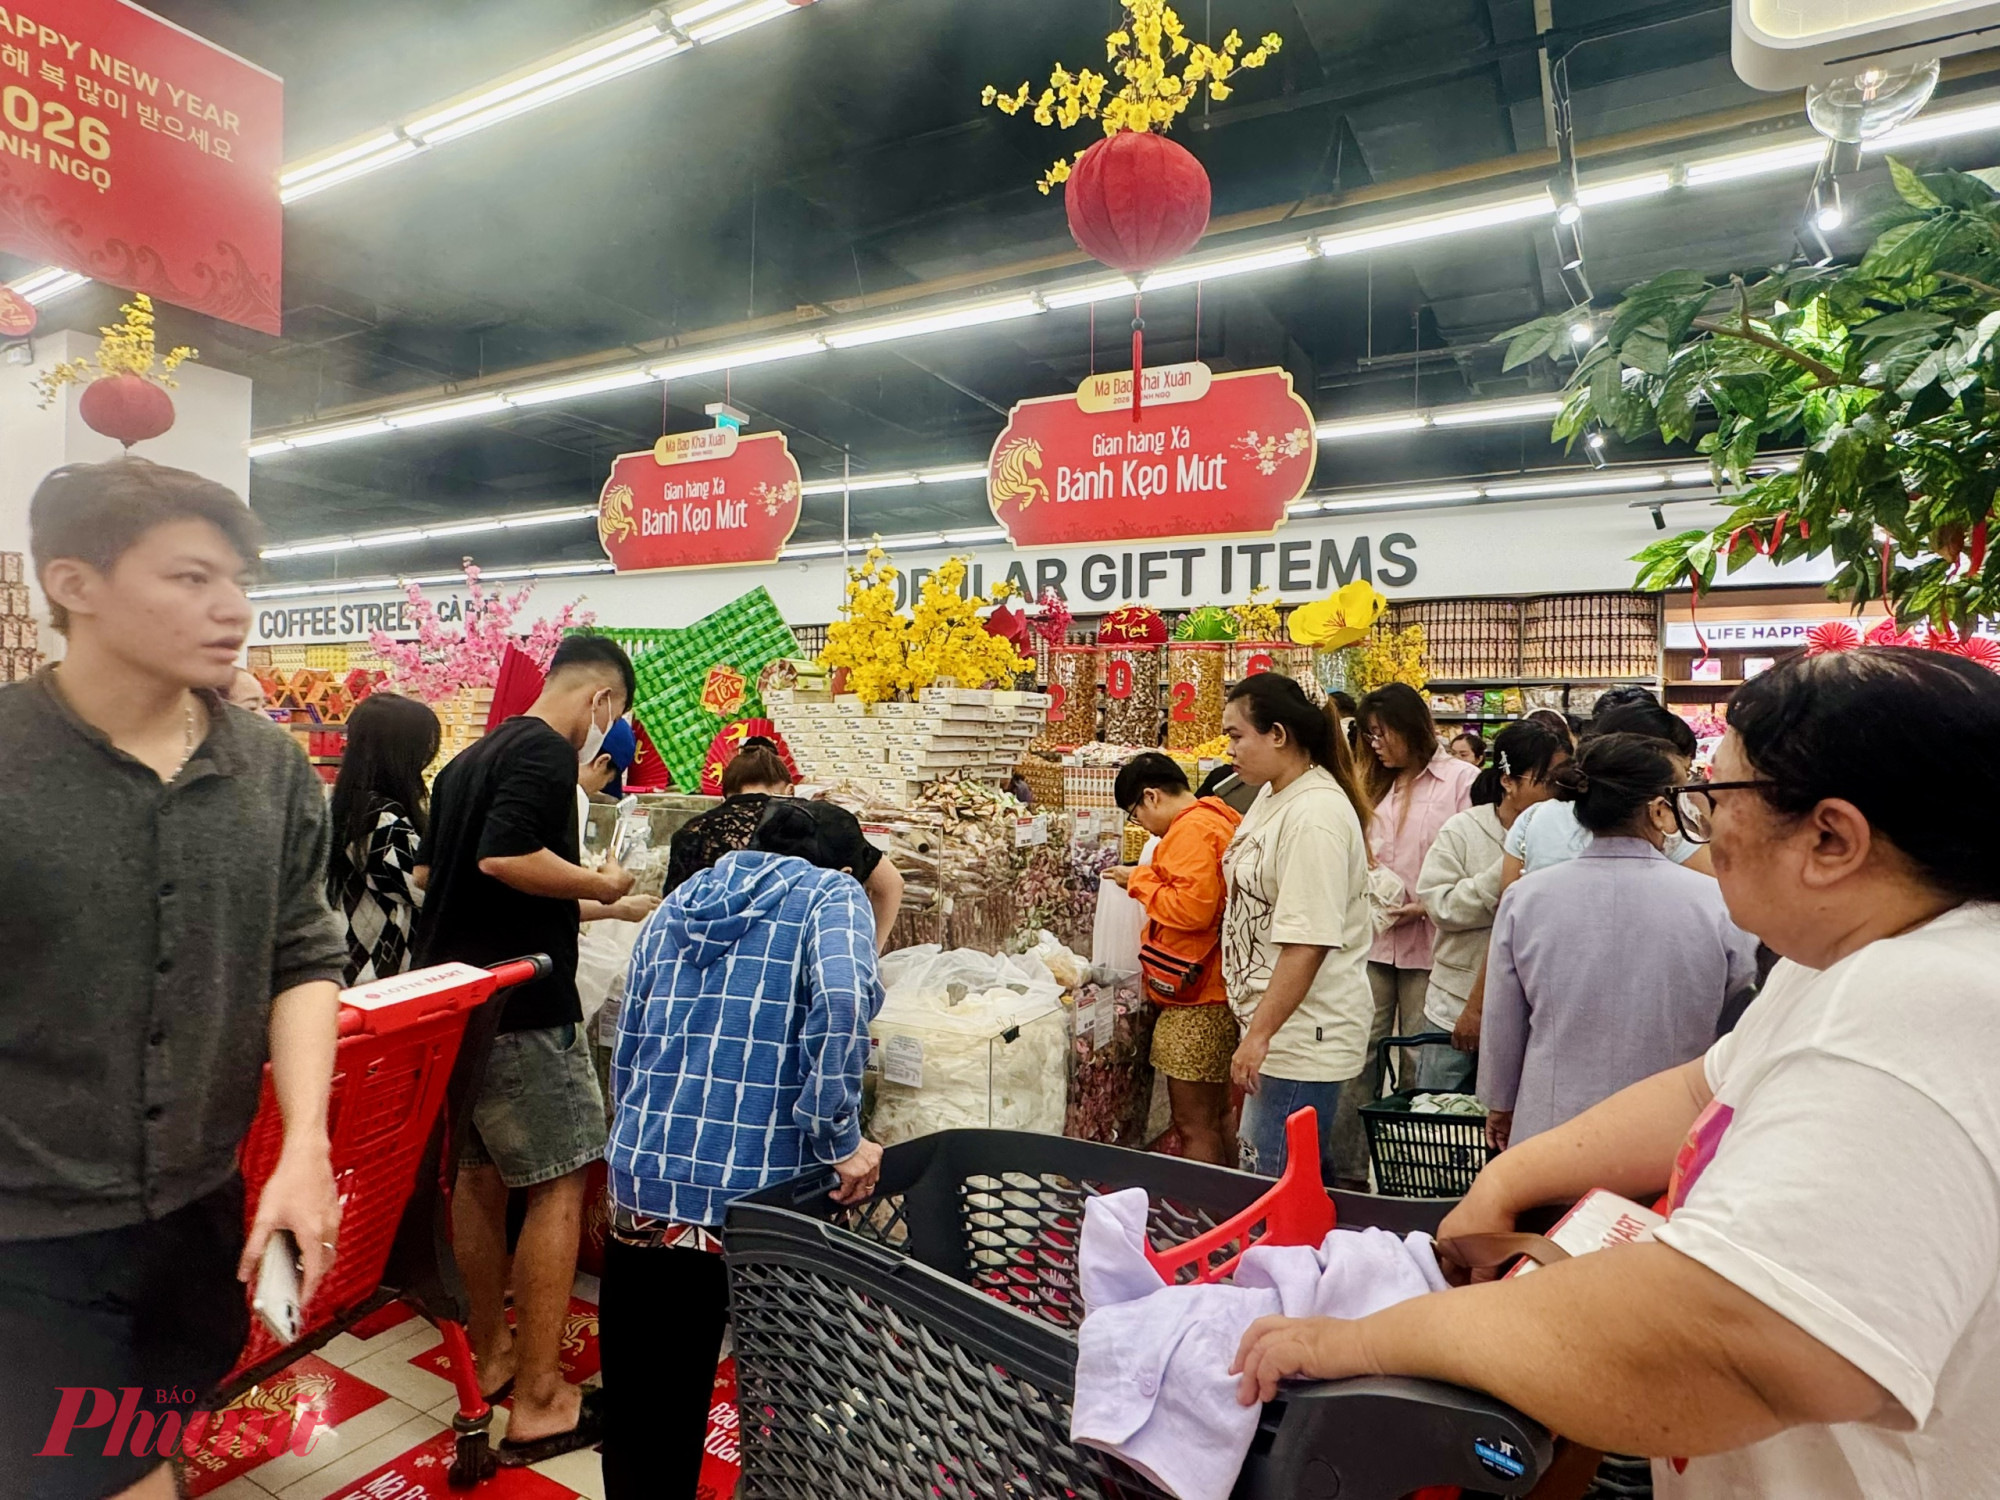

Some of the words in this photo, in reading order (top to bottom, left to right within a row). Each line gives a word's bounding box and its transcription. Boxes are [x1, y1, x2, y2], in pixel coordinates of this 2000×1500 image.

[0, 5, 82, 60] APPY
[90, 47, 160, 97] NEW
[165, 82, 240, 136] YEAR
[3, 85, 111, 160] 026
[38, 59, 67, 92] 복
[75, 74, 127, 118] 많이
[136, 102, 234, 163] 받으세요
[49, 148, 112, 194] NGỌ
[1138, 371, 1160, 391] hai
[1092, 433, 1123, 458] Gian
[1127, 430, 1166, 455] hàng
[663, 482, 684, 501] Gian
[685, 480, 710, 500] hàng
[1056, 461, 1114, 503] Bánh
[1121, 459, 1168, 500] Kẹo
[1176, 453, 1228, 493] Mứt
[641, 504, 678, 536] Bánh
[682, 502, 711, 535] Kẹo
[716, 498, 748, 530] Mứt
[1081, 547, 1205, 601] GIFT
[1221, 532, 1417, 594] ITEMS
[259, 606, 337, 640] COFFEE
[1707, 628, 1746, 640] LIFE
[1172, 682, 1196, 721] 2
[381, 978, 423, 997] LOTTE
[426, 968, 465, 984] MART
